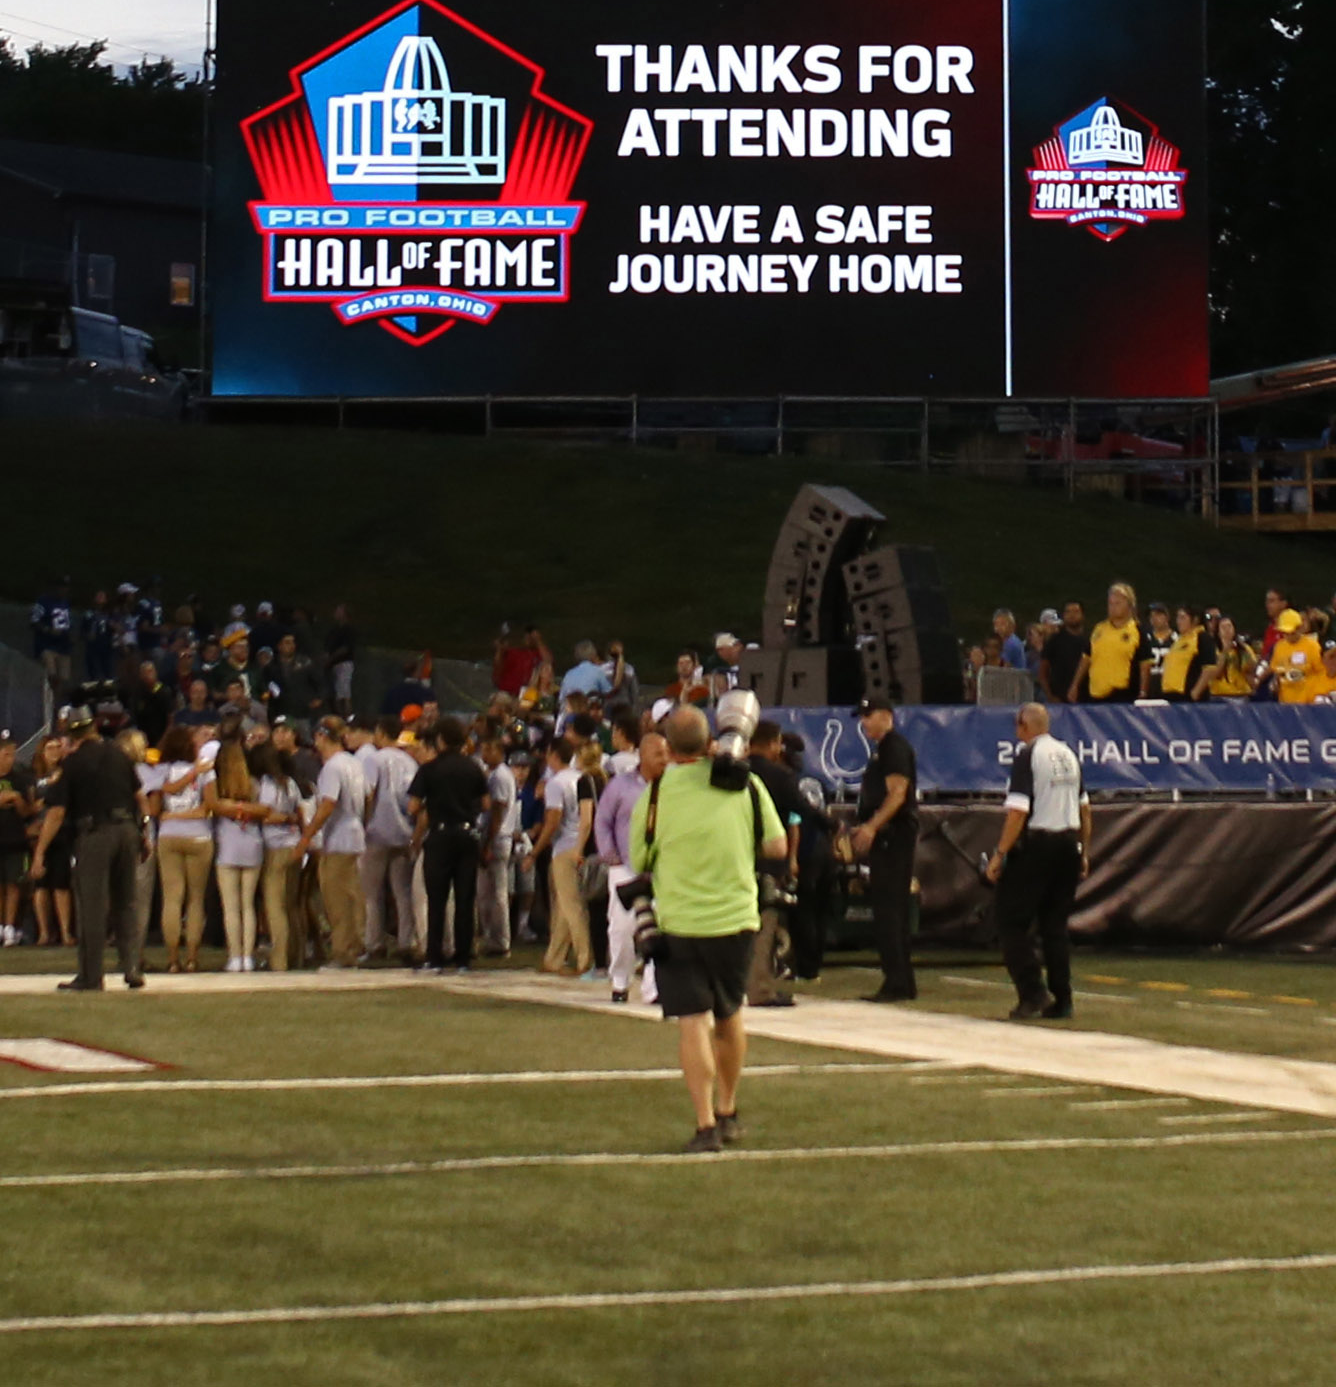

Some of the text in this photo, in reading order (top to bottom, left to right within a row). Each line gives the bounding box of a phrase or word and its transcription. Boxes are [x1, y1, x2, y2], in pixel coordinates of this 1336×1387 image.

[595, 44, 975, 94] THANKS FOR
[617, 108, 952, 158] ATTENDING
[1032, 170, 1182, 181] PRO FOOTBALL
[1036, 183, 1178, 209] HALL OF FAME
[267, 208, 567, 227] PRO FOOTBALL
[639, 204, 933, 244] HAVE A SAFE
[277, 238, 556, 287] HALL OF FAME
[608, 254, 963, 294] JOURNEY HOME
[437, 295, 487, 317] OHIO
[1079, 739, 1159, 764] HALL
[1168, 739, 1213, 764] OF
[1222, 739, 1310, 764] FAME
